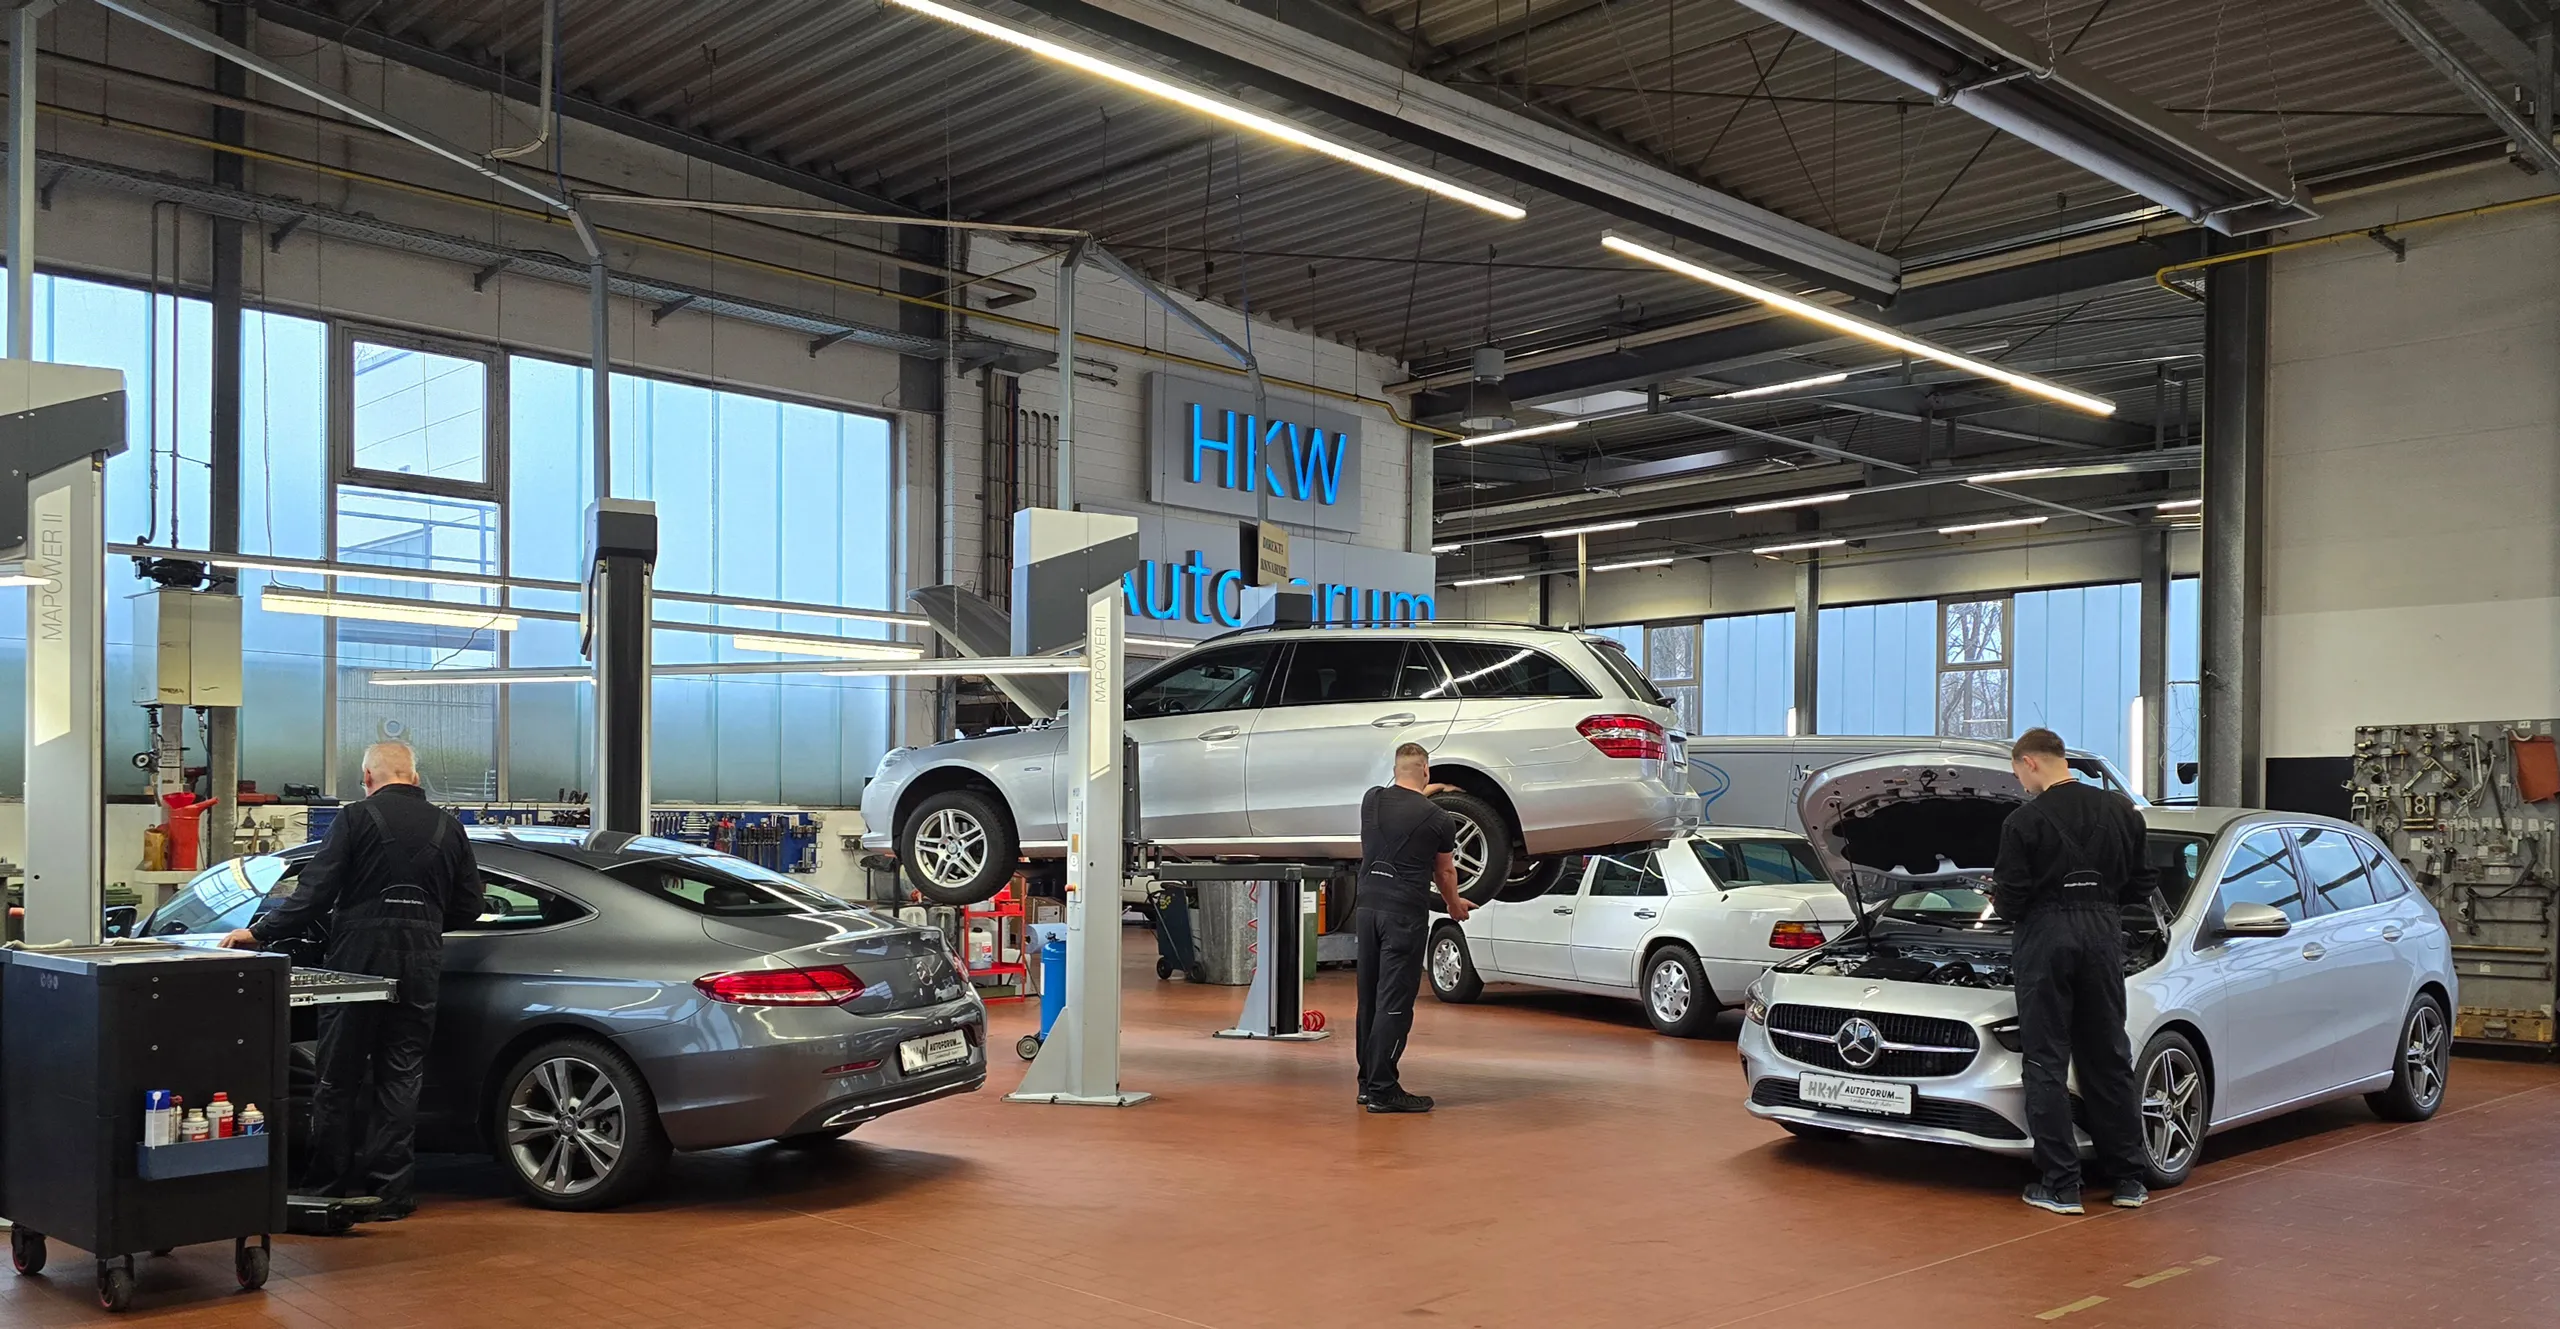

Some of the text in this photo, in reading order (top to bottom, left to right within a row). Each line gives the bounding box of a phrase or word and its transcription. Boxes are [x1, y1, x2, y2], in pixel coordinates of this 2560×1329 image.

[1192, 404, 1348, 505] HKW
[41, 529, 63, 641] MAPOWER
[1123, 550, 1435, 630] utorum
[1094, 626, 1107, 703] MAPOWER
[1844, 1085, 1895, 1100] AUTOFORUM
